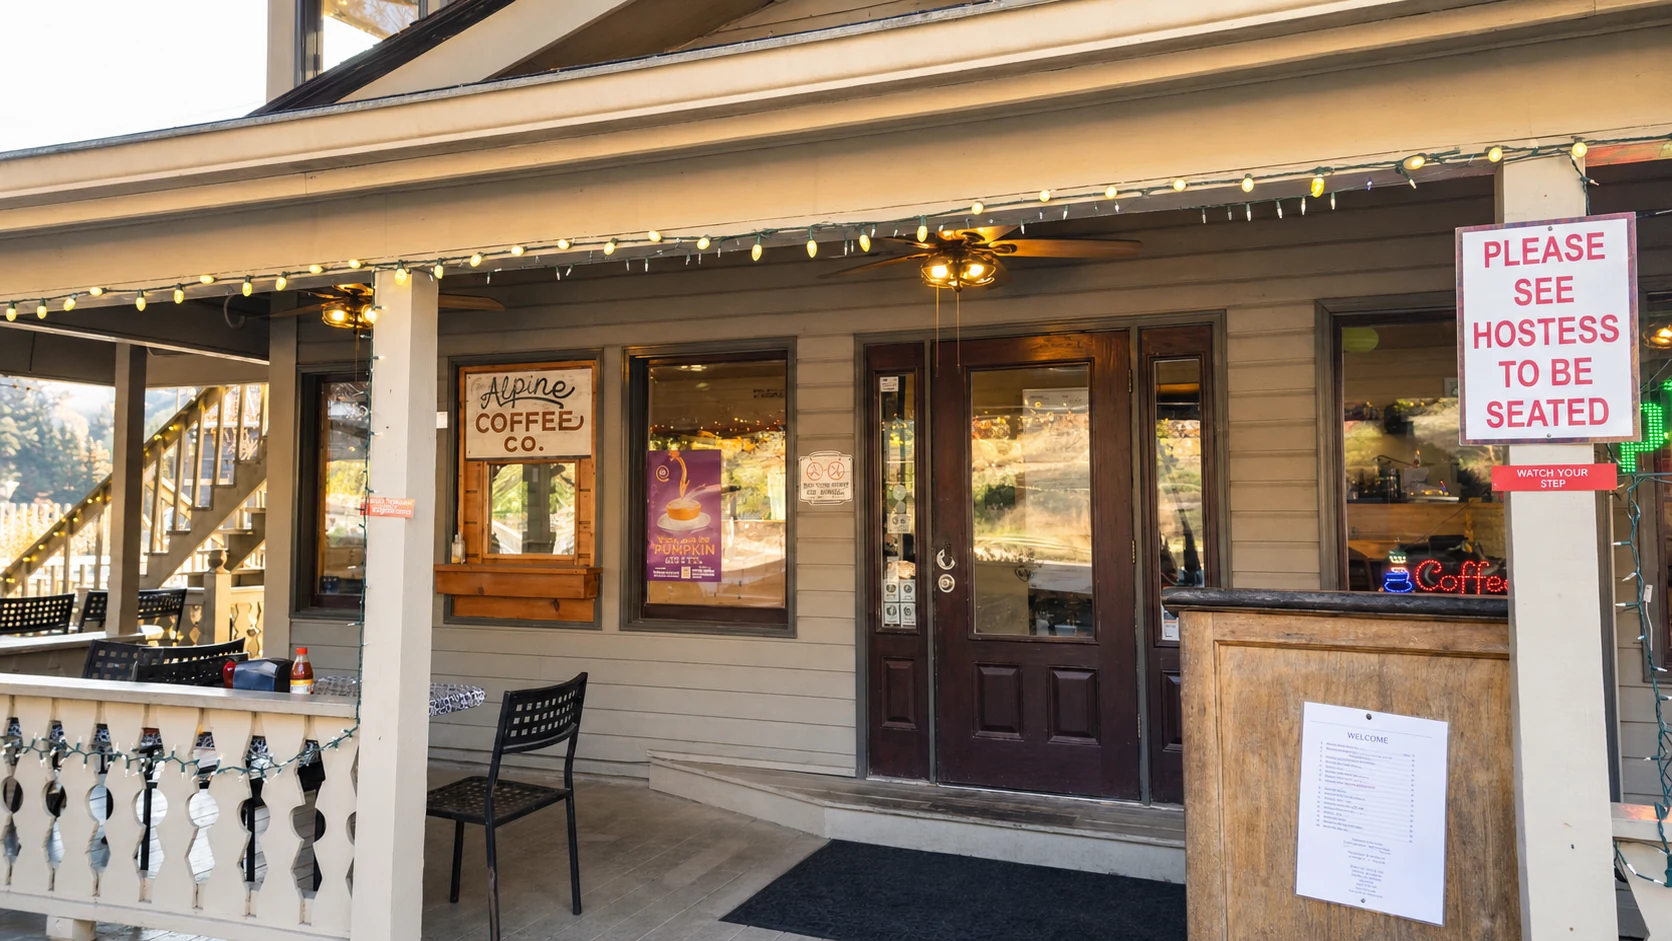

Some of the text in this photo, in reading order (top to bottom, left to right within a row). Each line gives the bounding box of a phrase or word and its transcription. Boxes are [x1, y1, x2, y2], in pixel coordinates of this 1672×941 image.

[1484, 232, 1605, 268] PLEASE
[1514, 276, 1574, 306] SEE
[1474, 314, 1619, 349] HOSTESS
[1498, 357, 1593, 388] TO BE
[481, 375, 575, 409] Alpine
[475, 410, 584, 434] COFFEE
[1486, 397, 1609, 428] SEATED
[503, 436, 544, 452] CO.
[1516, 468, 1588, 478] WATCH YOUR
[1540, 479, 1566, 489] STEP
[654, 544, 715, 555] PUMPKIN
[1415, 559, 1508, 595] Coffe
[1347, 732, 1389, 744] WELCOME
